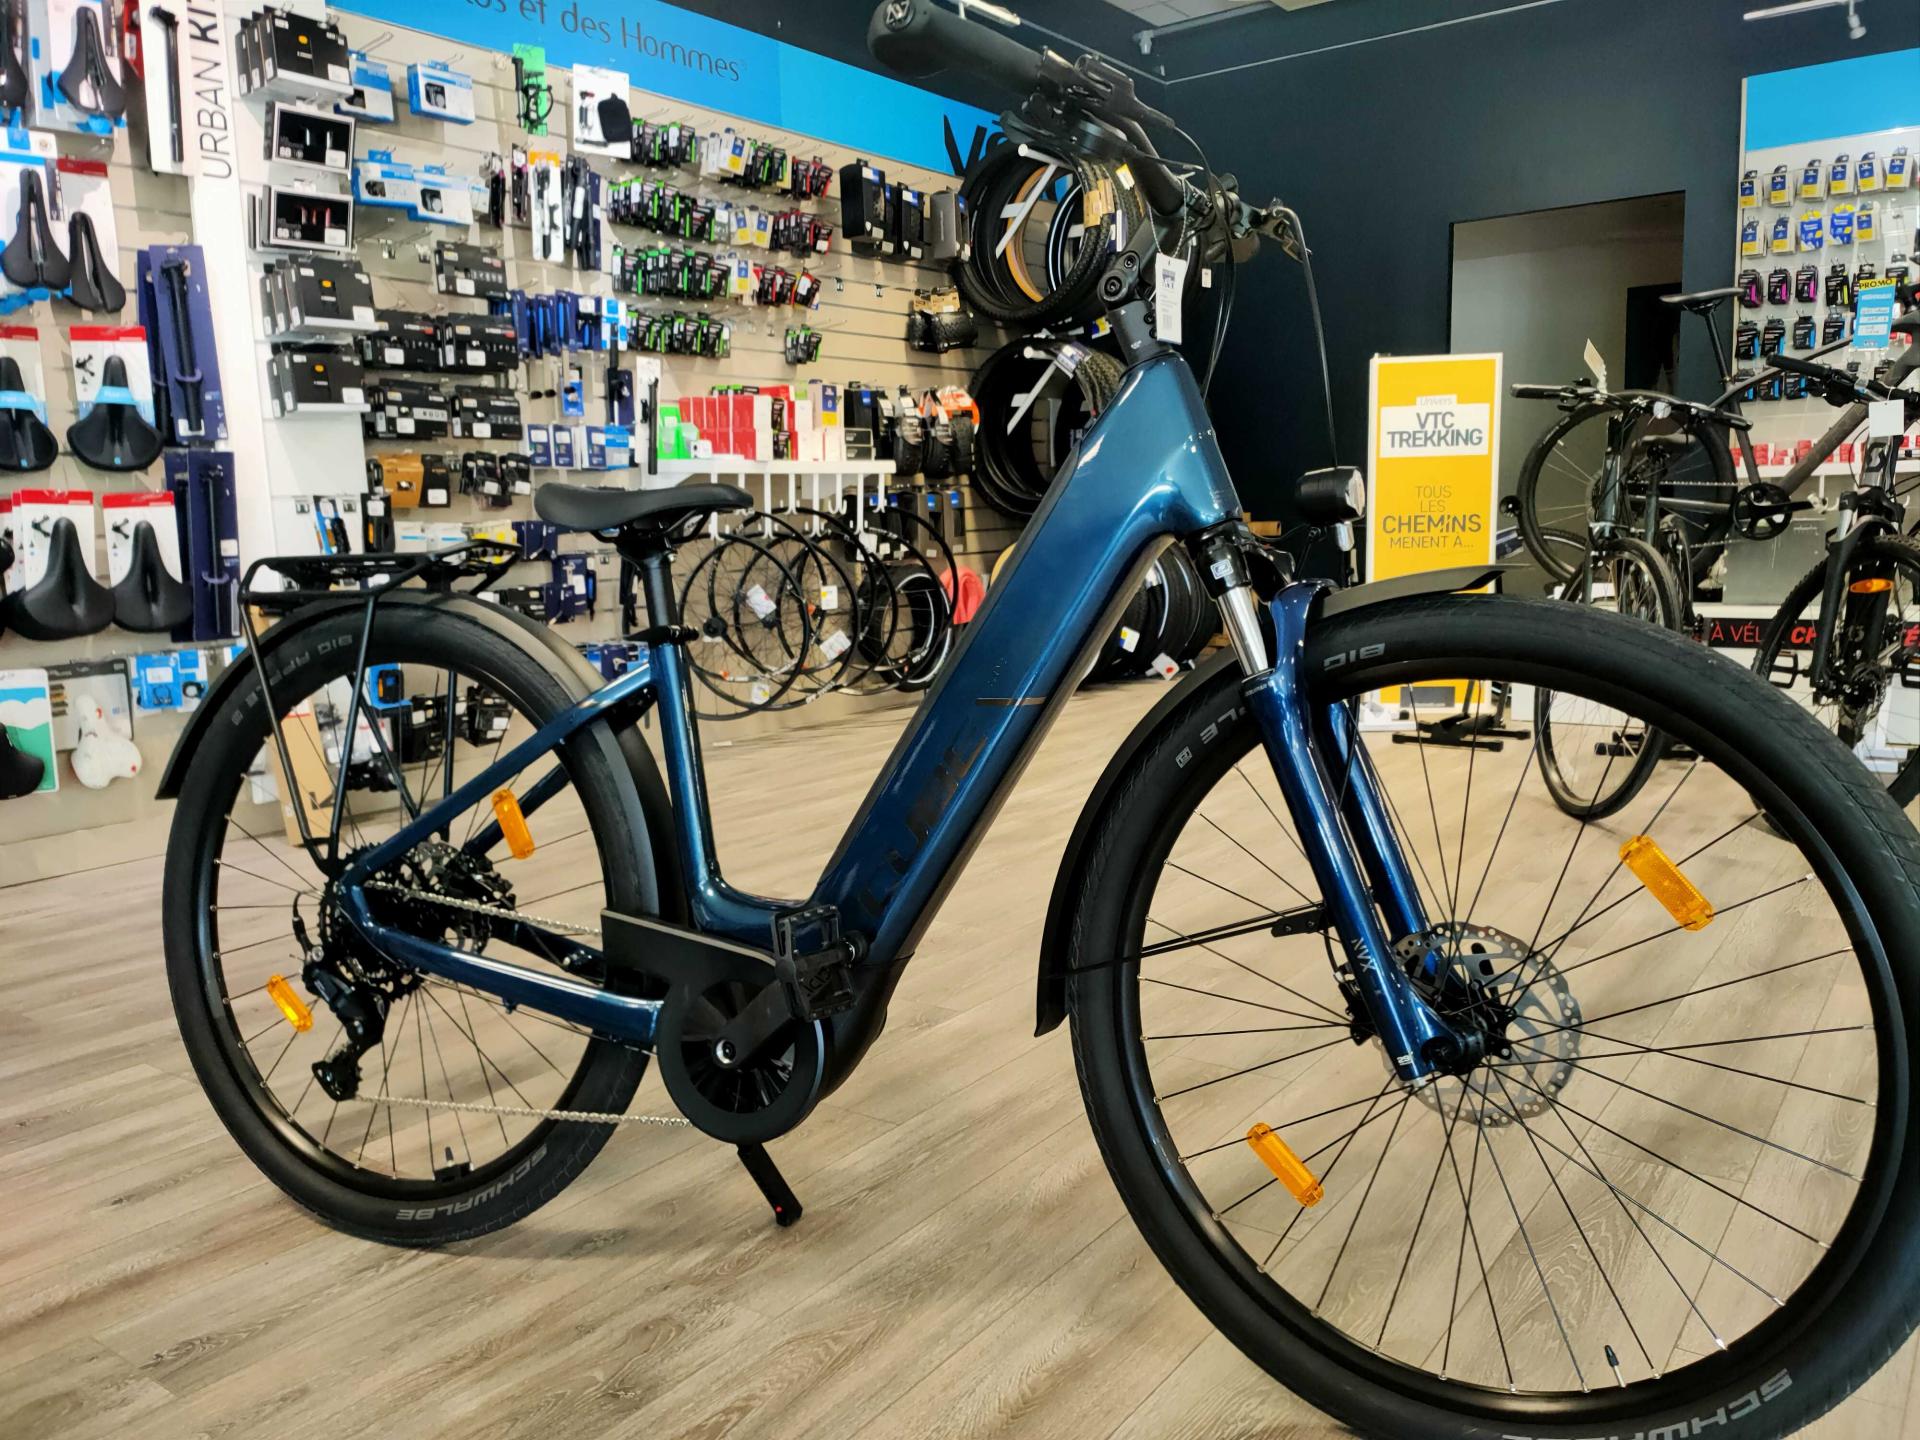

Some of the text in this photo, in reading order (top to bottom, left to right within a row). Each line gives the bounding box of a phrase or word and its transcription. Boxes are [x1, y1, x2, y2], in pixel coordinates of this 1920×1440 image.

[561, 2, 611, 44] des
[620, 16, 740, 82] Hommes
[187, 0, 232, 180] URBAN KI
[1416, 411, 1455, 430] VTC
[1387, 428, 1484, 449] TREKKING
[1415, 485, 1452, 499] TOUS
[1420, 500, 1446, 513] LES
[1389, 536, 1449, 549] MENENT
[1729, 620, 1763, 643] VÉL
[1322, 641, 1387, 673] BIG
[395, 1143, 548, 1221] SCHWALBE
